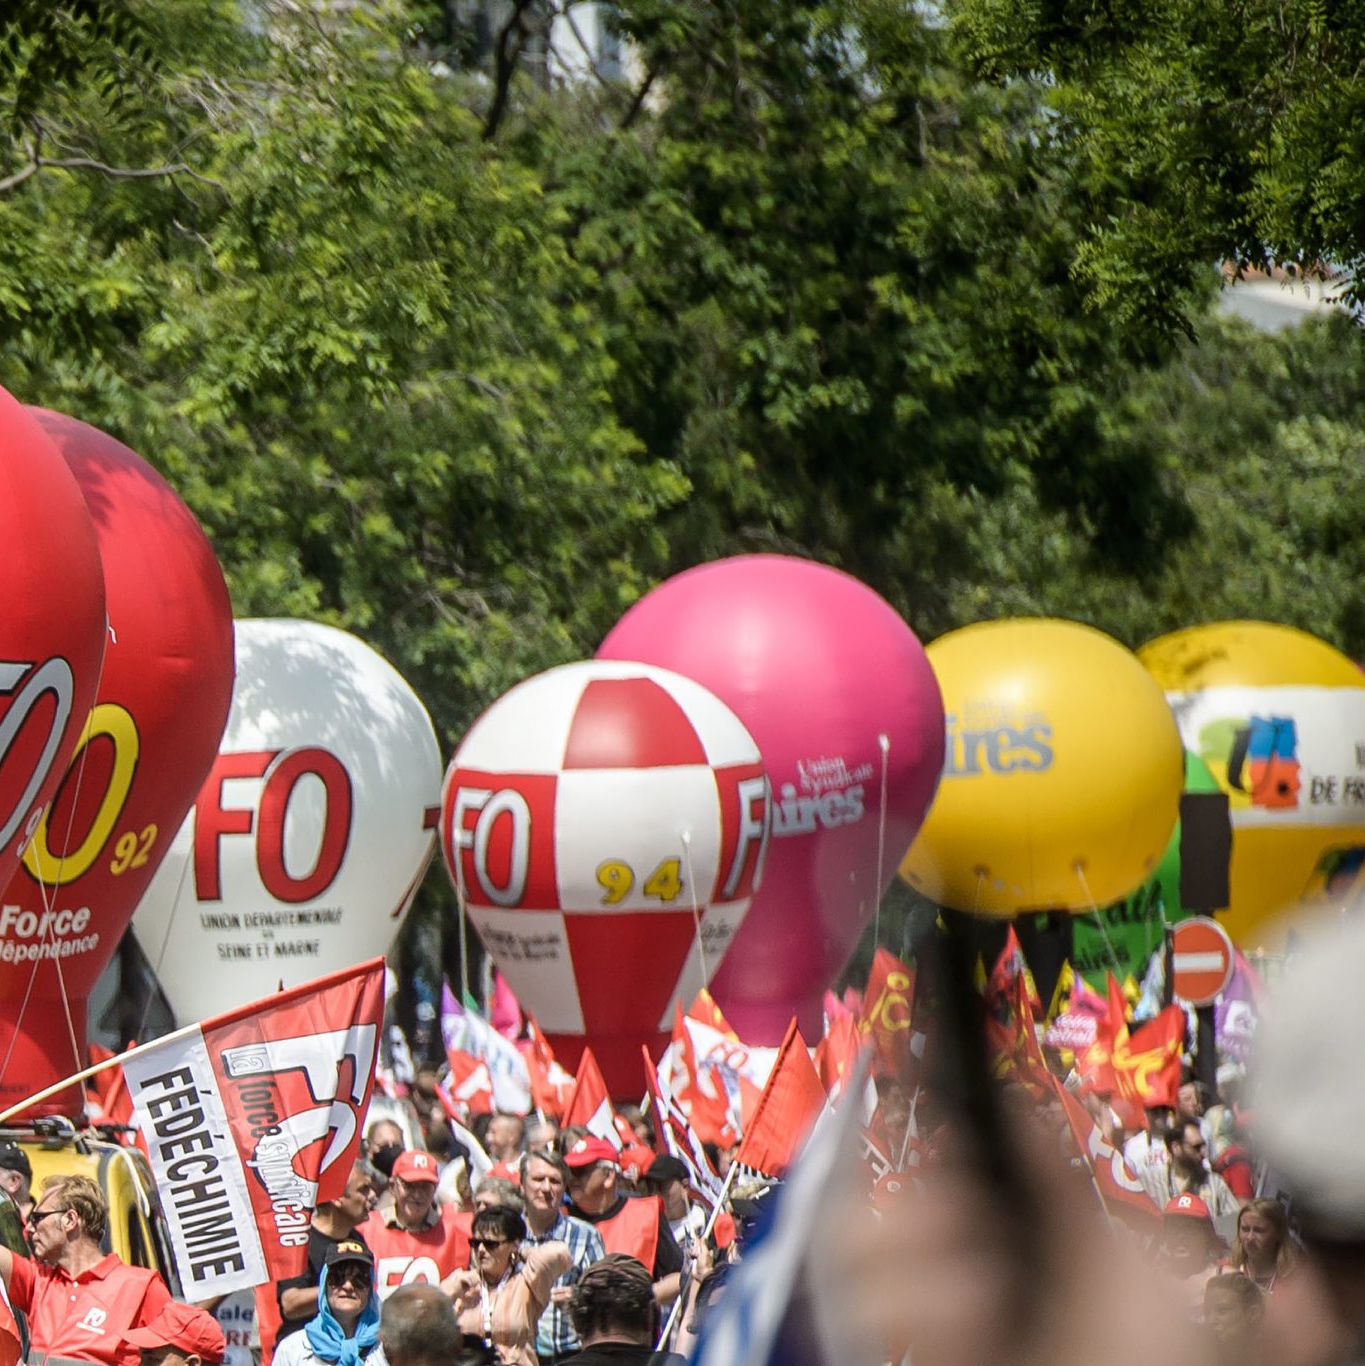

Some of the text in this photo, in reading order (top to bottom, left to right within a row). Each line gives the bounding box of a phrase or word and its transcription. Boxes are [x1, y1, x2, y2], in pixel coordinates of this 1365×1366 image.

[110, 823, 158, 876] 92
[193, 746, 353, 903] FO
[453, 787, 531, 907] FO
[596, 856, 684, 904] 94
[238, 1080, 283, 1139] force
[139, 1066, 246, 1283] FÉDÉCHIMIE
[245, 1141, 311, 1248] syndicale
